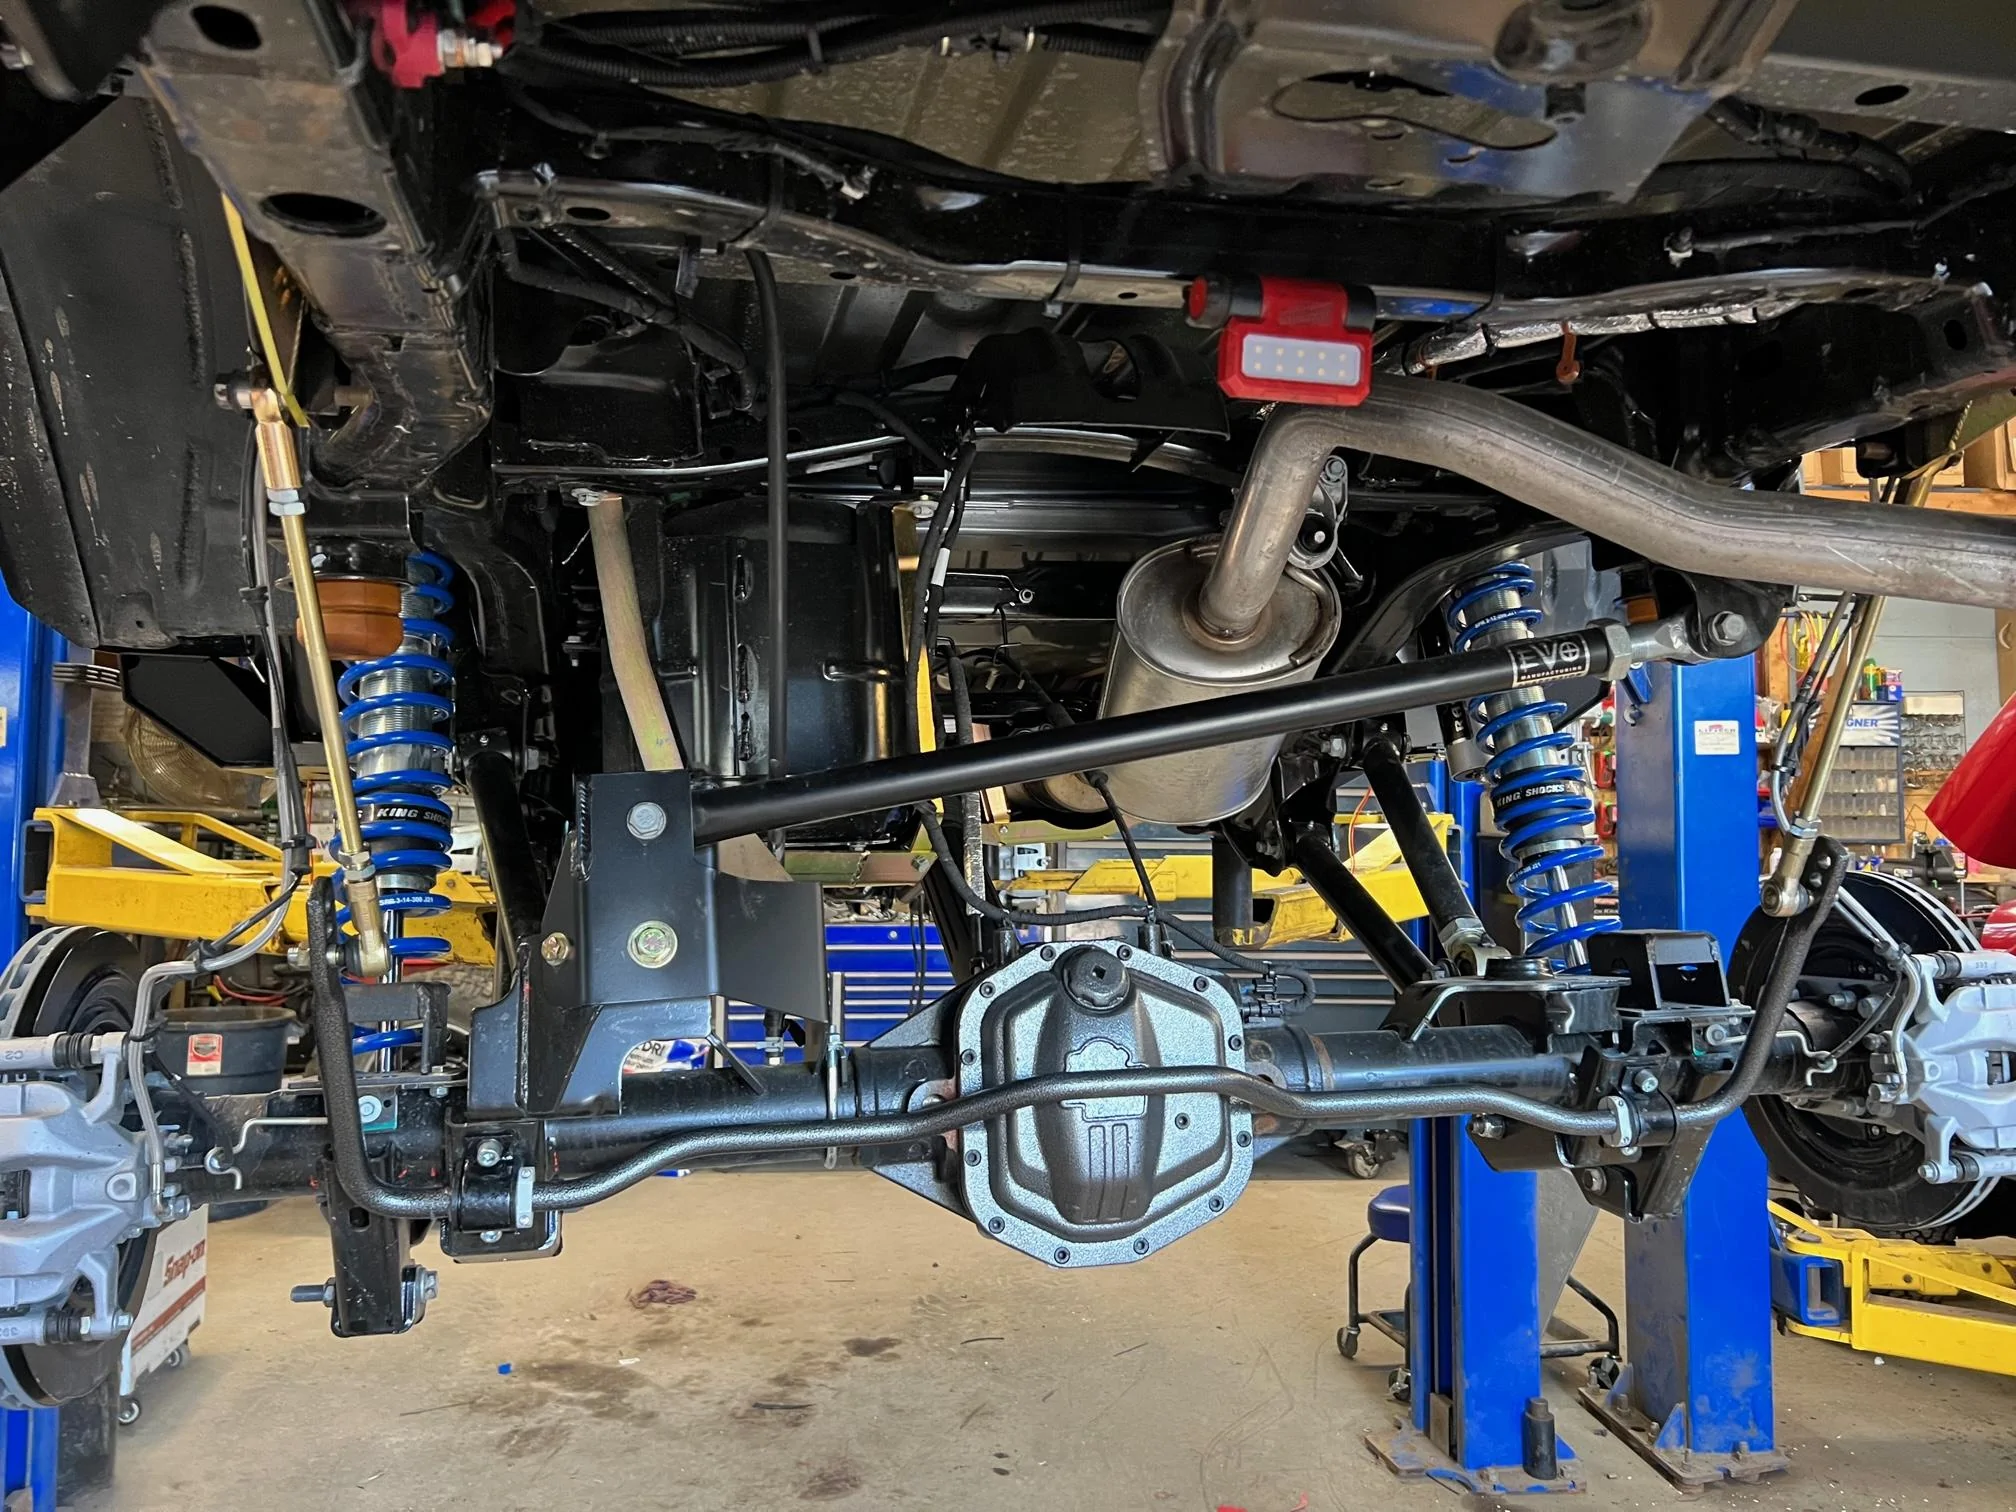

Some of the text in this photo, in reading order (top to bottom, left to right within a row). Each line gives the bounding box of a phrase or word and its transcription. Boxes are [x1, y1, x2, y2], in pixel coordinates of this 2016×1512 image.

[1518, 640, 1580, 672] EVO
[1520, 665, 1583, 680] MANUFACTURING
[1846, 718, 1878, 728] GNER
[1525, 784, 1565, 797] SHOCKS
[377, 807, 419, 818] KING
